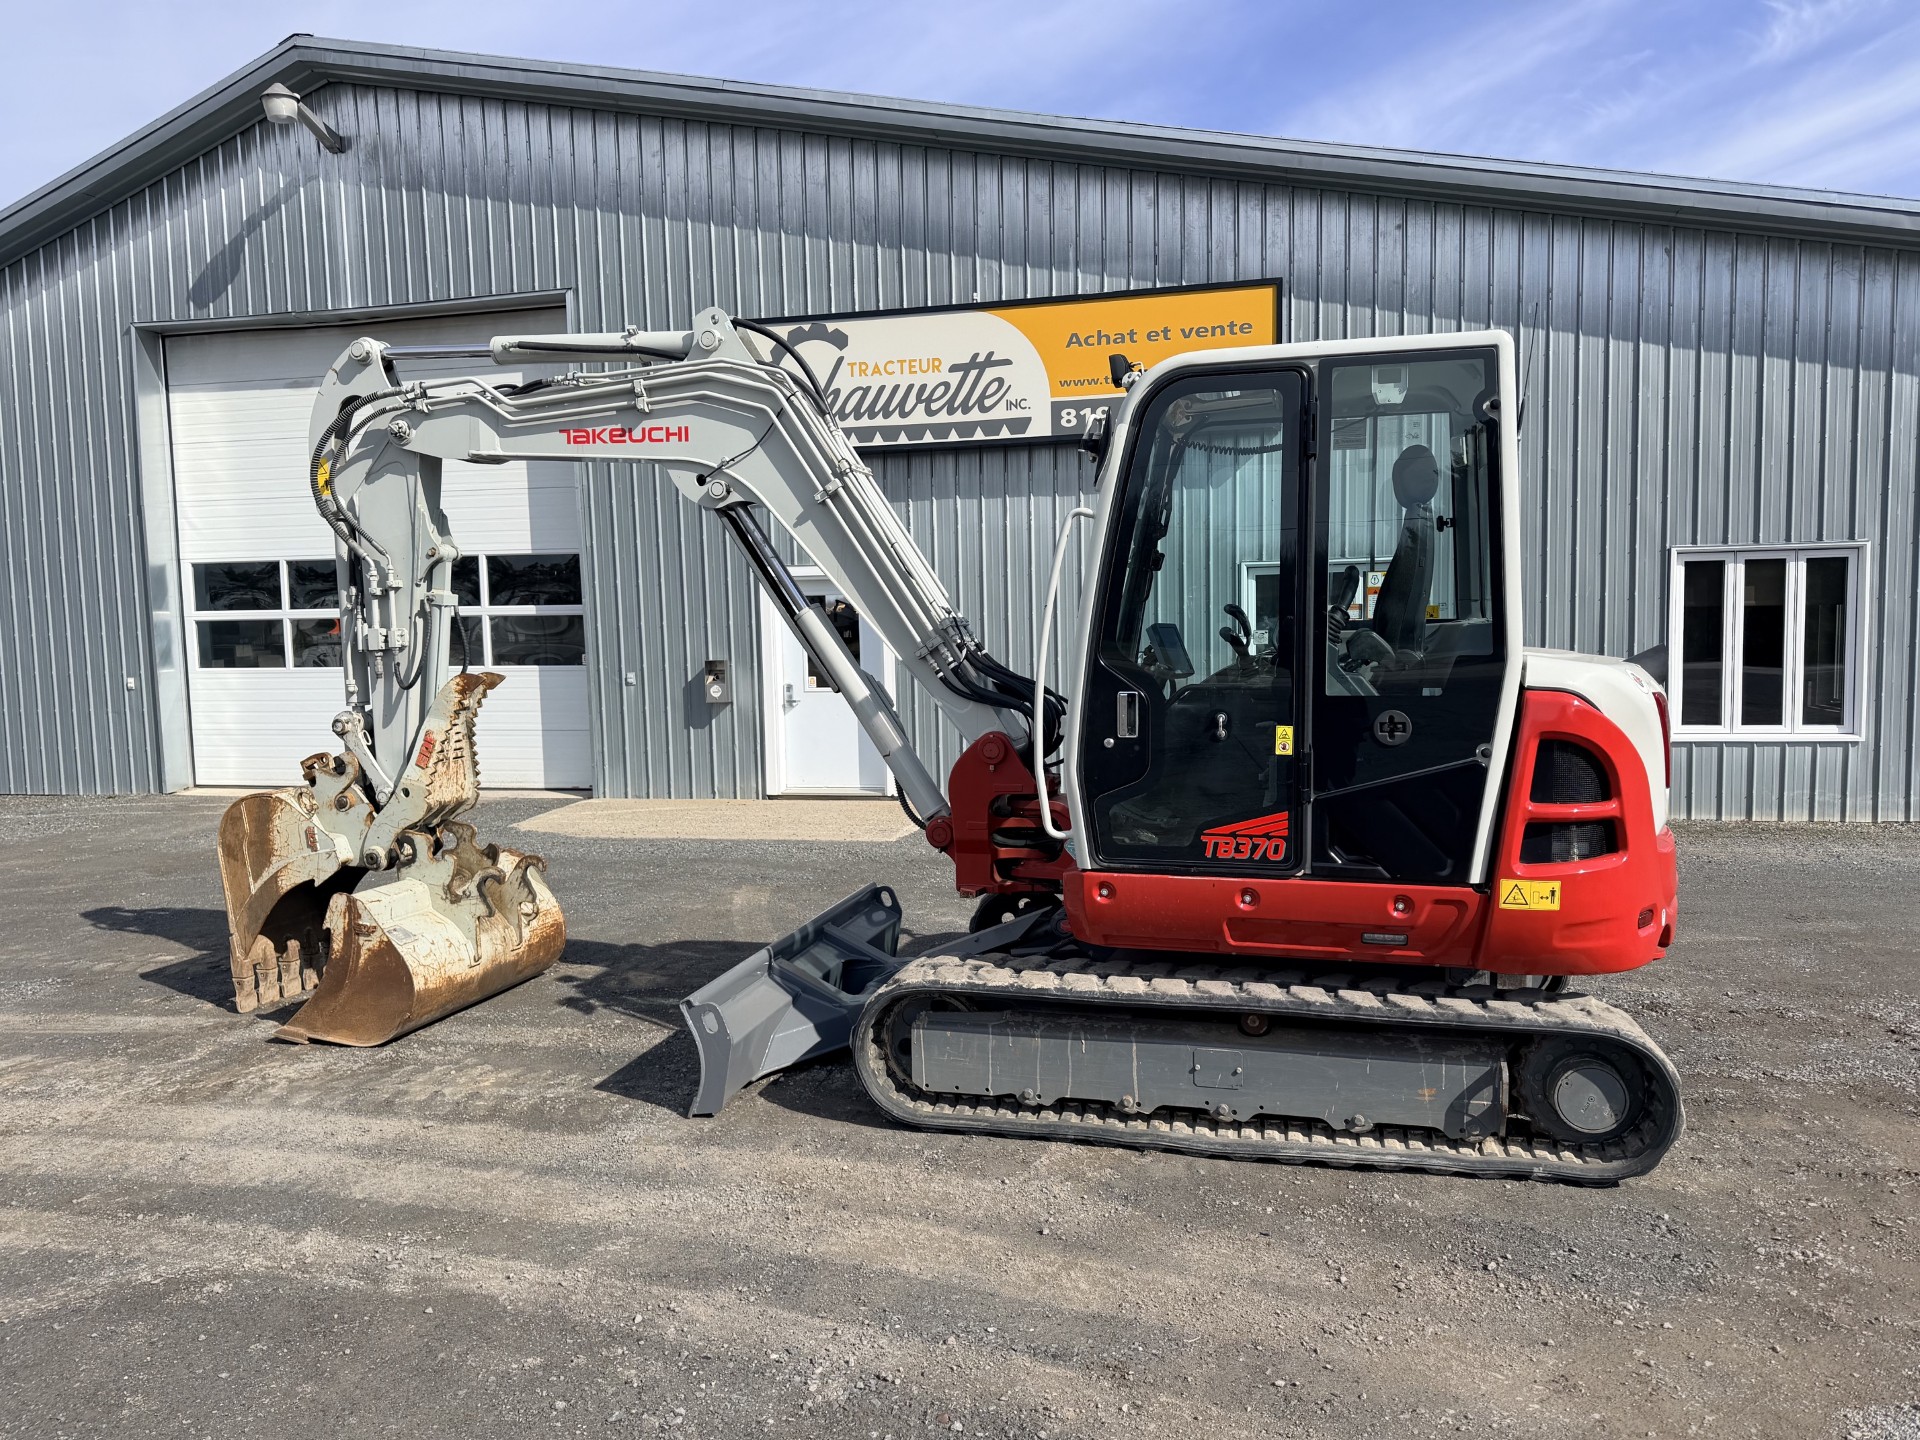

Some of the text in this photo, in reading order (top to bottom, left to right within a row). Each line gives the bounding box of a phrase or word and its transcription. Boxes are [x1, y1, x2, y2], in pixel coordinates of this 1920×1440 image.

[1065, 320, 1253, 348] Achat et vente
[847, 357, 942, 378] TRACTEUR
[1059, 375, 1112, 388] www.t
[1005, 398, 1031, 411] INC.
[559, 426, 689, 444] TAKEUCHI
[1200, 835, 1286, 860] TB370
